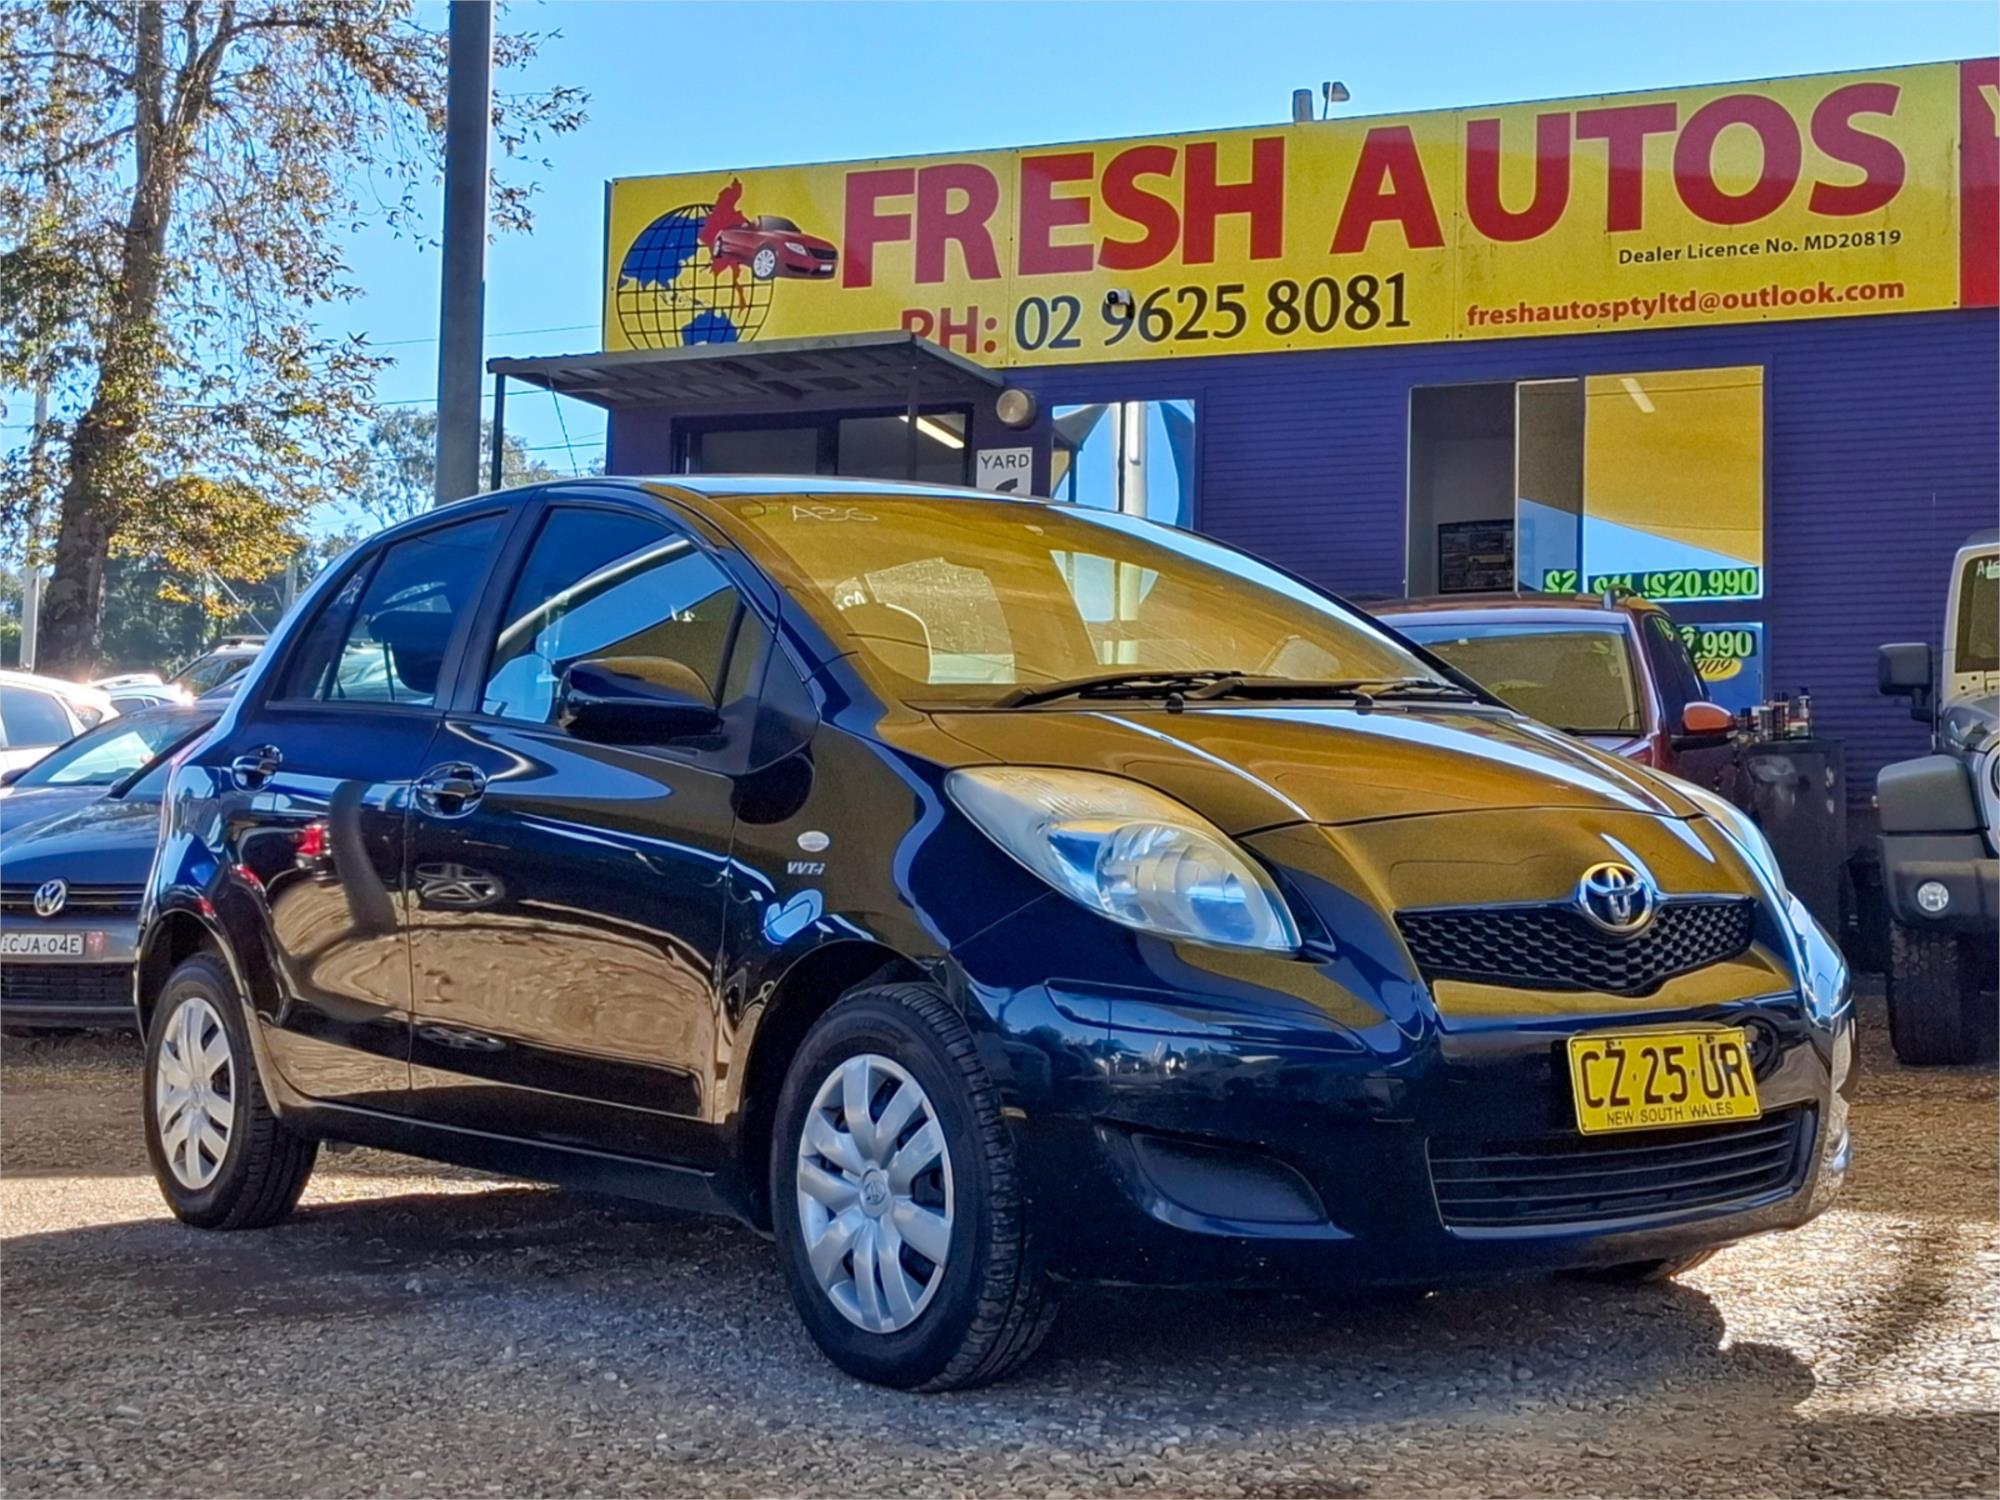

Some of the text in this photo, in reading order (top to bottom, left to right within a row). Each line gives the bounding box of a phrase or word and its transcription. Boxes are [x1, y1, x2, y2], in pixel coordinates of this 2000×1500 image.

[842, 82, 1908, 289] FRESH AUTOS
[1618, 229, 1902, 265] Dealer Licence No. MD20819
[901, 271, 1412, 354] PH: 02 9625 8081
[1466, 280, 1905, 326] freshautosptyltd@outlook.com
[980, 453, 1031, 470] YARD
[1606, 1101, 1735, 1127] NEW SOUTH WALES
